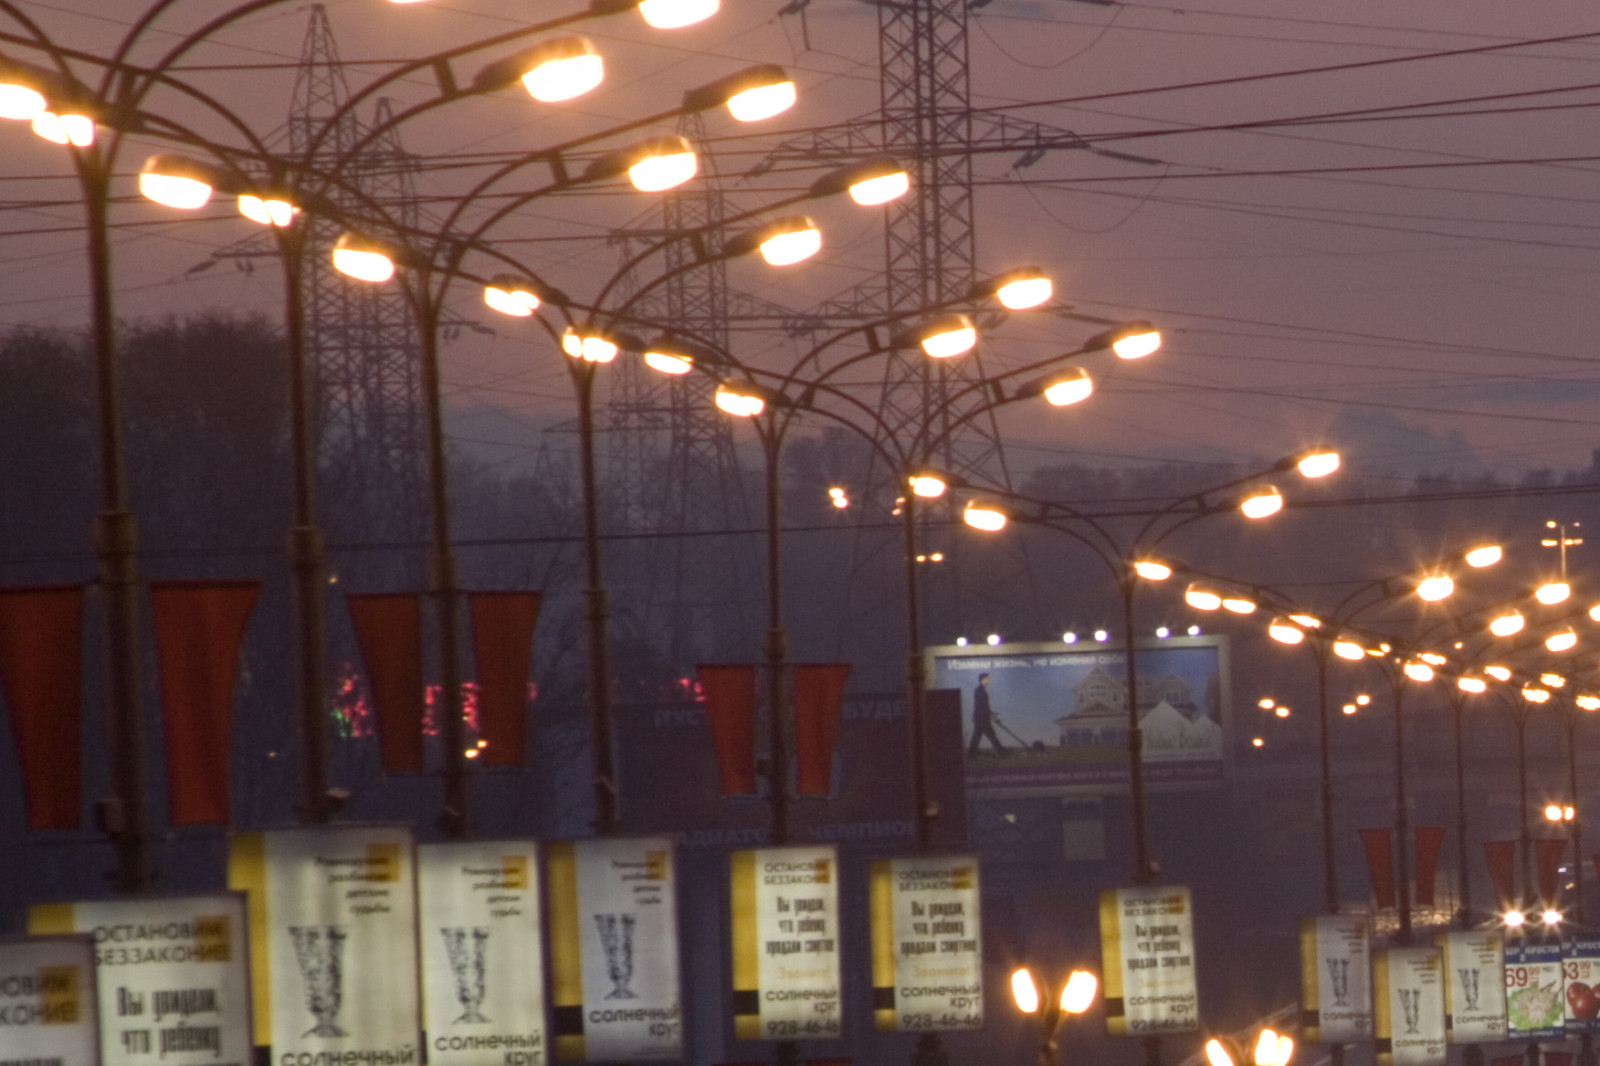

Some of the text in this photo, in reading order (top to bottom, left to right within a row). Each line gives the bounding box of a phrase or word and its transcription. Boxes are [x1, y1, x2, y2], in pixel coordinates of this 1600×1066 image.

[766, 987, 838, 1002] солнечный
[901, 984, 981, 999] солнечный
[117, 986, 142, 1017] Вы
[950, 996, 981, 1011] круг
[589, 1003, 681, 1024] солнечный
[902, 1013, 981, 1028] 928-46-46
[767, 1020, 839, 1035] 928-46-46
[121, 1028, 150, 1055] что
[435, 1030, 541, 1051] солнечный
